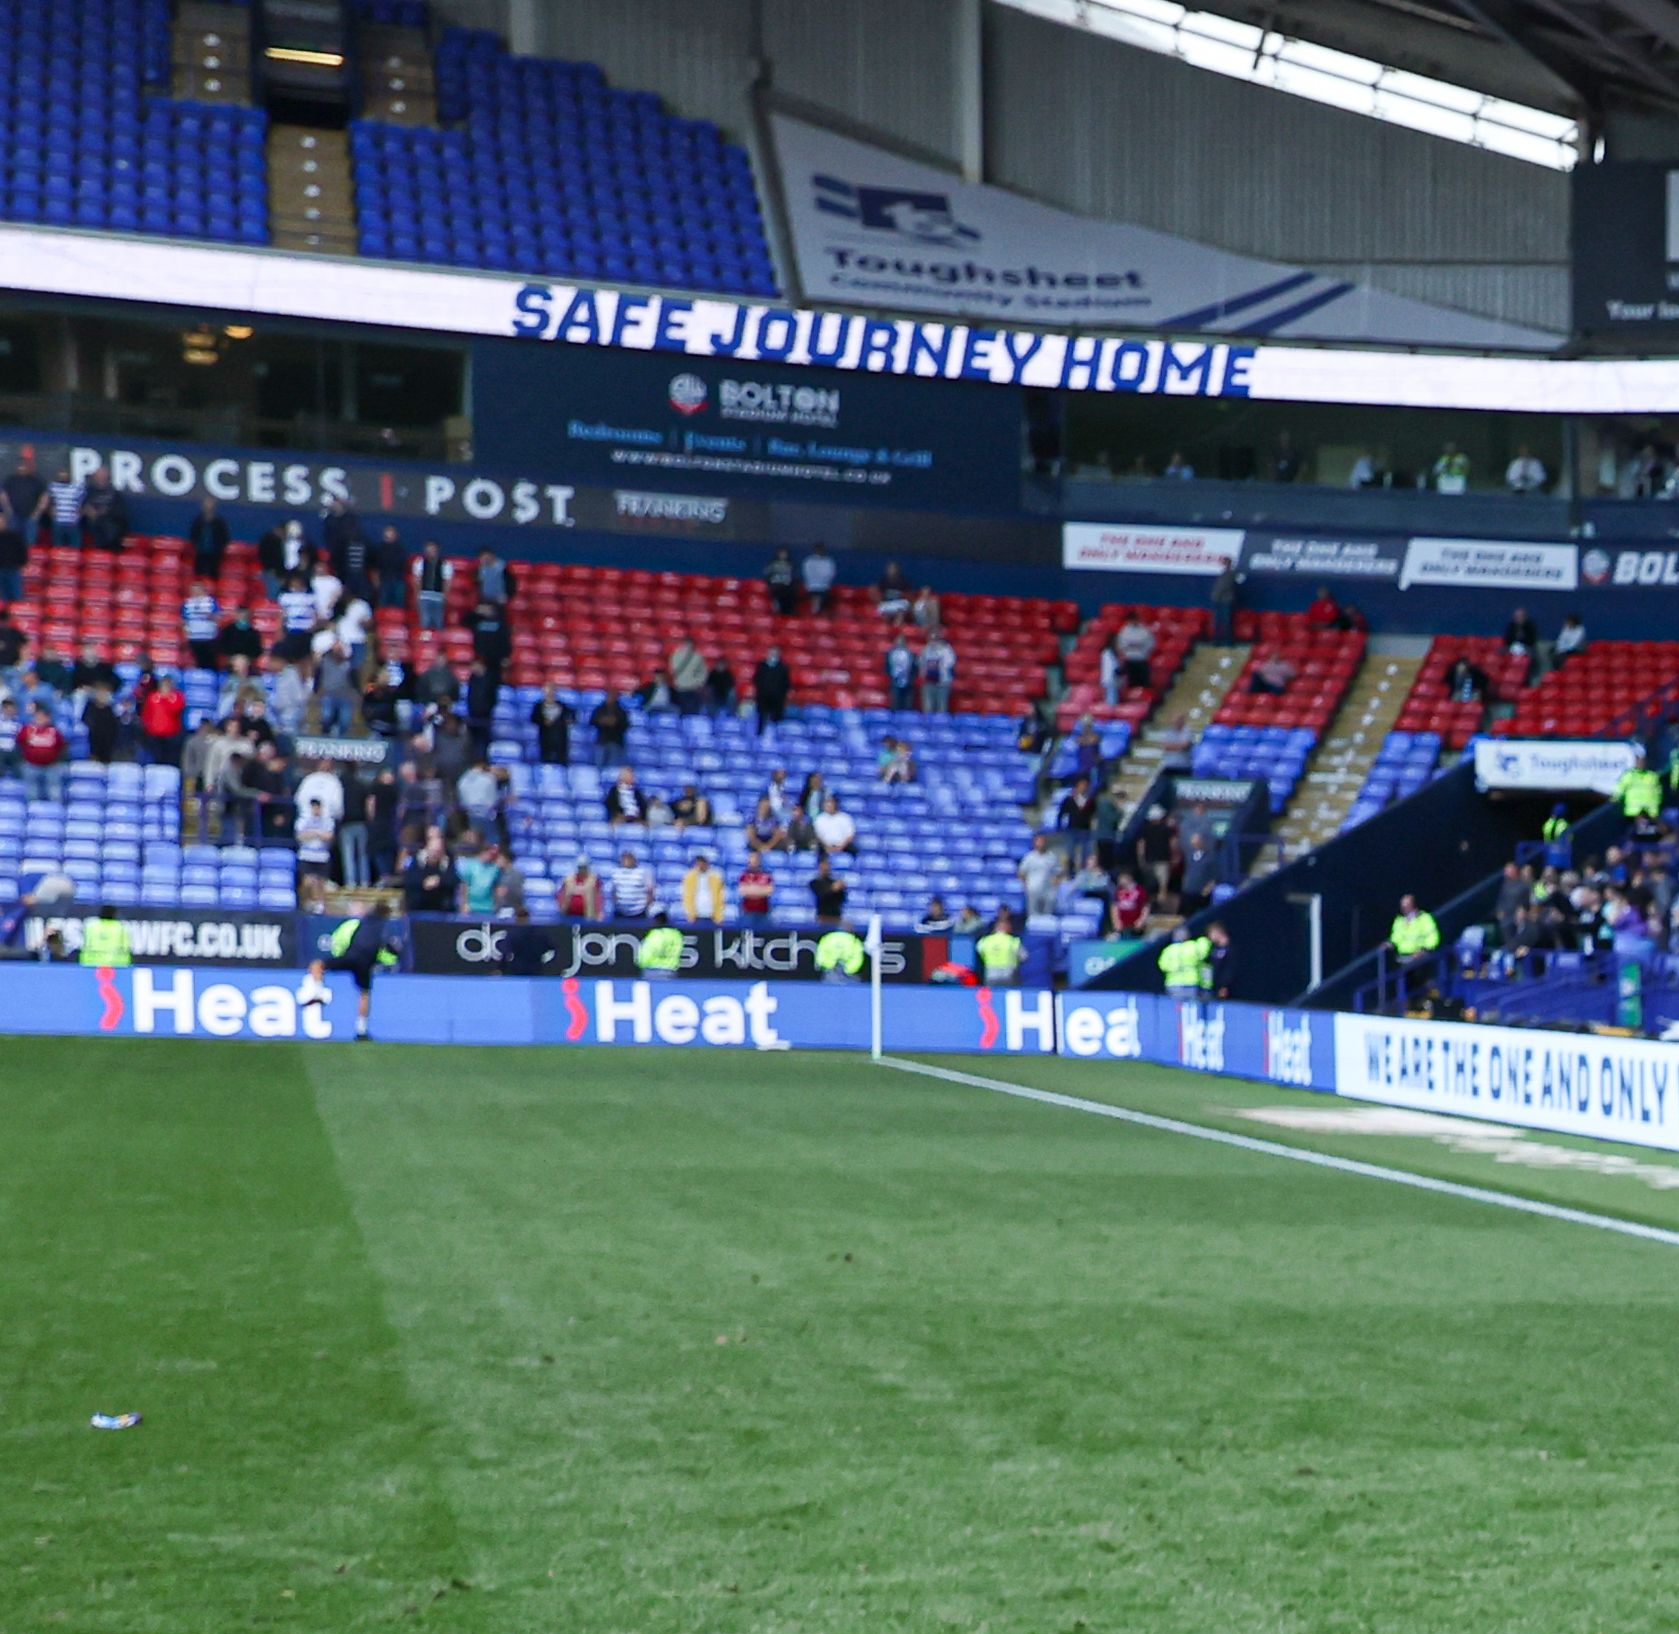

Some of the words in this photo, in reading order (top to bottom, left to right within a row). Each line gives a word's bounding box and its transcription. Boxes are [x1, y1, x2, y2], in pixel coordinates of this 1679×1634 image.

[826, 248, 1144, 290] Toughsheet
[512, 283, 695, 353] SAFE
[709, 301, 1041, 384] JOURNEY
[1058, 335, 1256, 398] HOME
[718, 378, 840, 412] BOLTON
[69, 447, 350, 507] PROCESS
[561, 923, 700, 978] jons
[714, 928, 907, 976] kitchs
[1364, 1030, 1392, 1085] WE
[1400, 1034, 1436, 1091] ARE
[1442, 1040, 1480, 1097] THE
[1490, 1045, 1533, 1105] ONE
[1543, 1050, 1590, 1113] AND
[1601, 1056, 1668, 1125] ONLY
